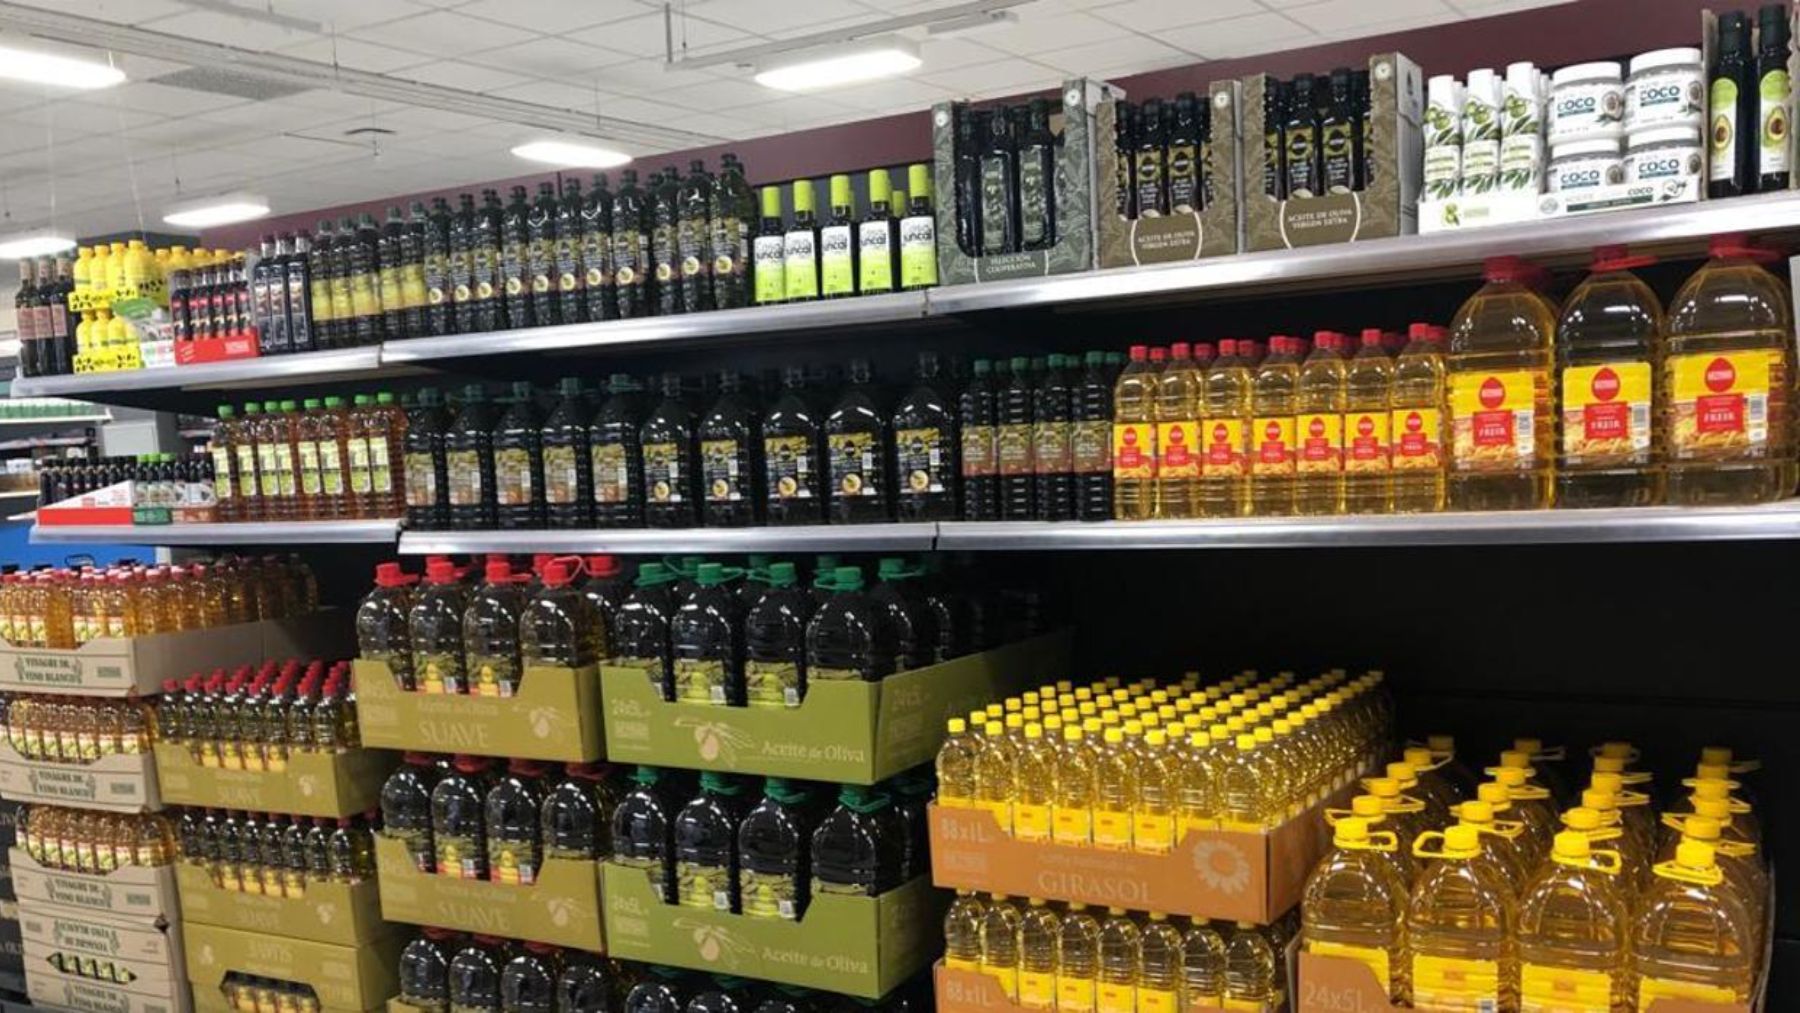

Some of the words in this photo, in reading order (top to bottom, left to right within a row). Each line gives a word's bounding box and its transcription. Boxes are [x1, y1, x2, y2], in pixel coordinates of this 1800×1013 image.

[1638, 159, 1679, 173] COCO
[1560, 170, 1600, 184] COCO
[1628, 186, 1654, 196] COCO
[418, 722, 489, 748] SUAVE
[762, 741, 806, 758] Aceite
[824, 744, 864, 762] Oliva
[1039, 869, 1149, 902] GIRASOL
[762, 947, 808, 966] Aceite
[826, 954, 868, 974] Oliva
